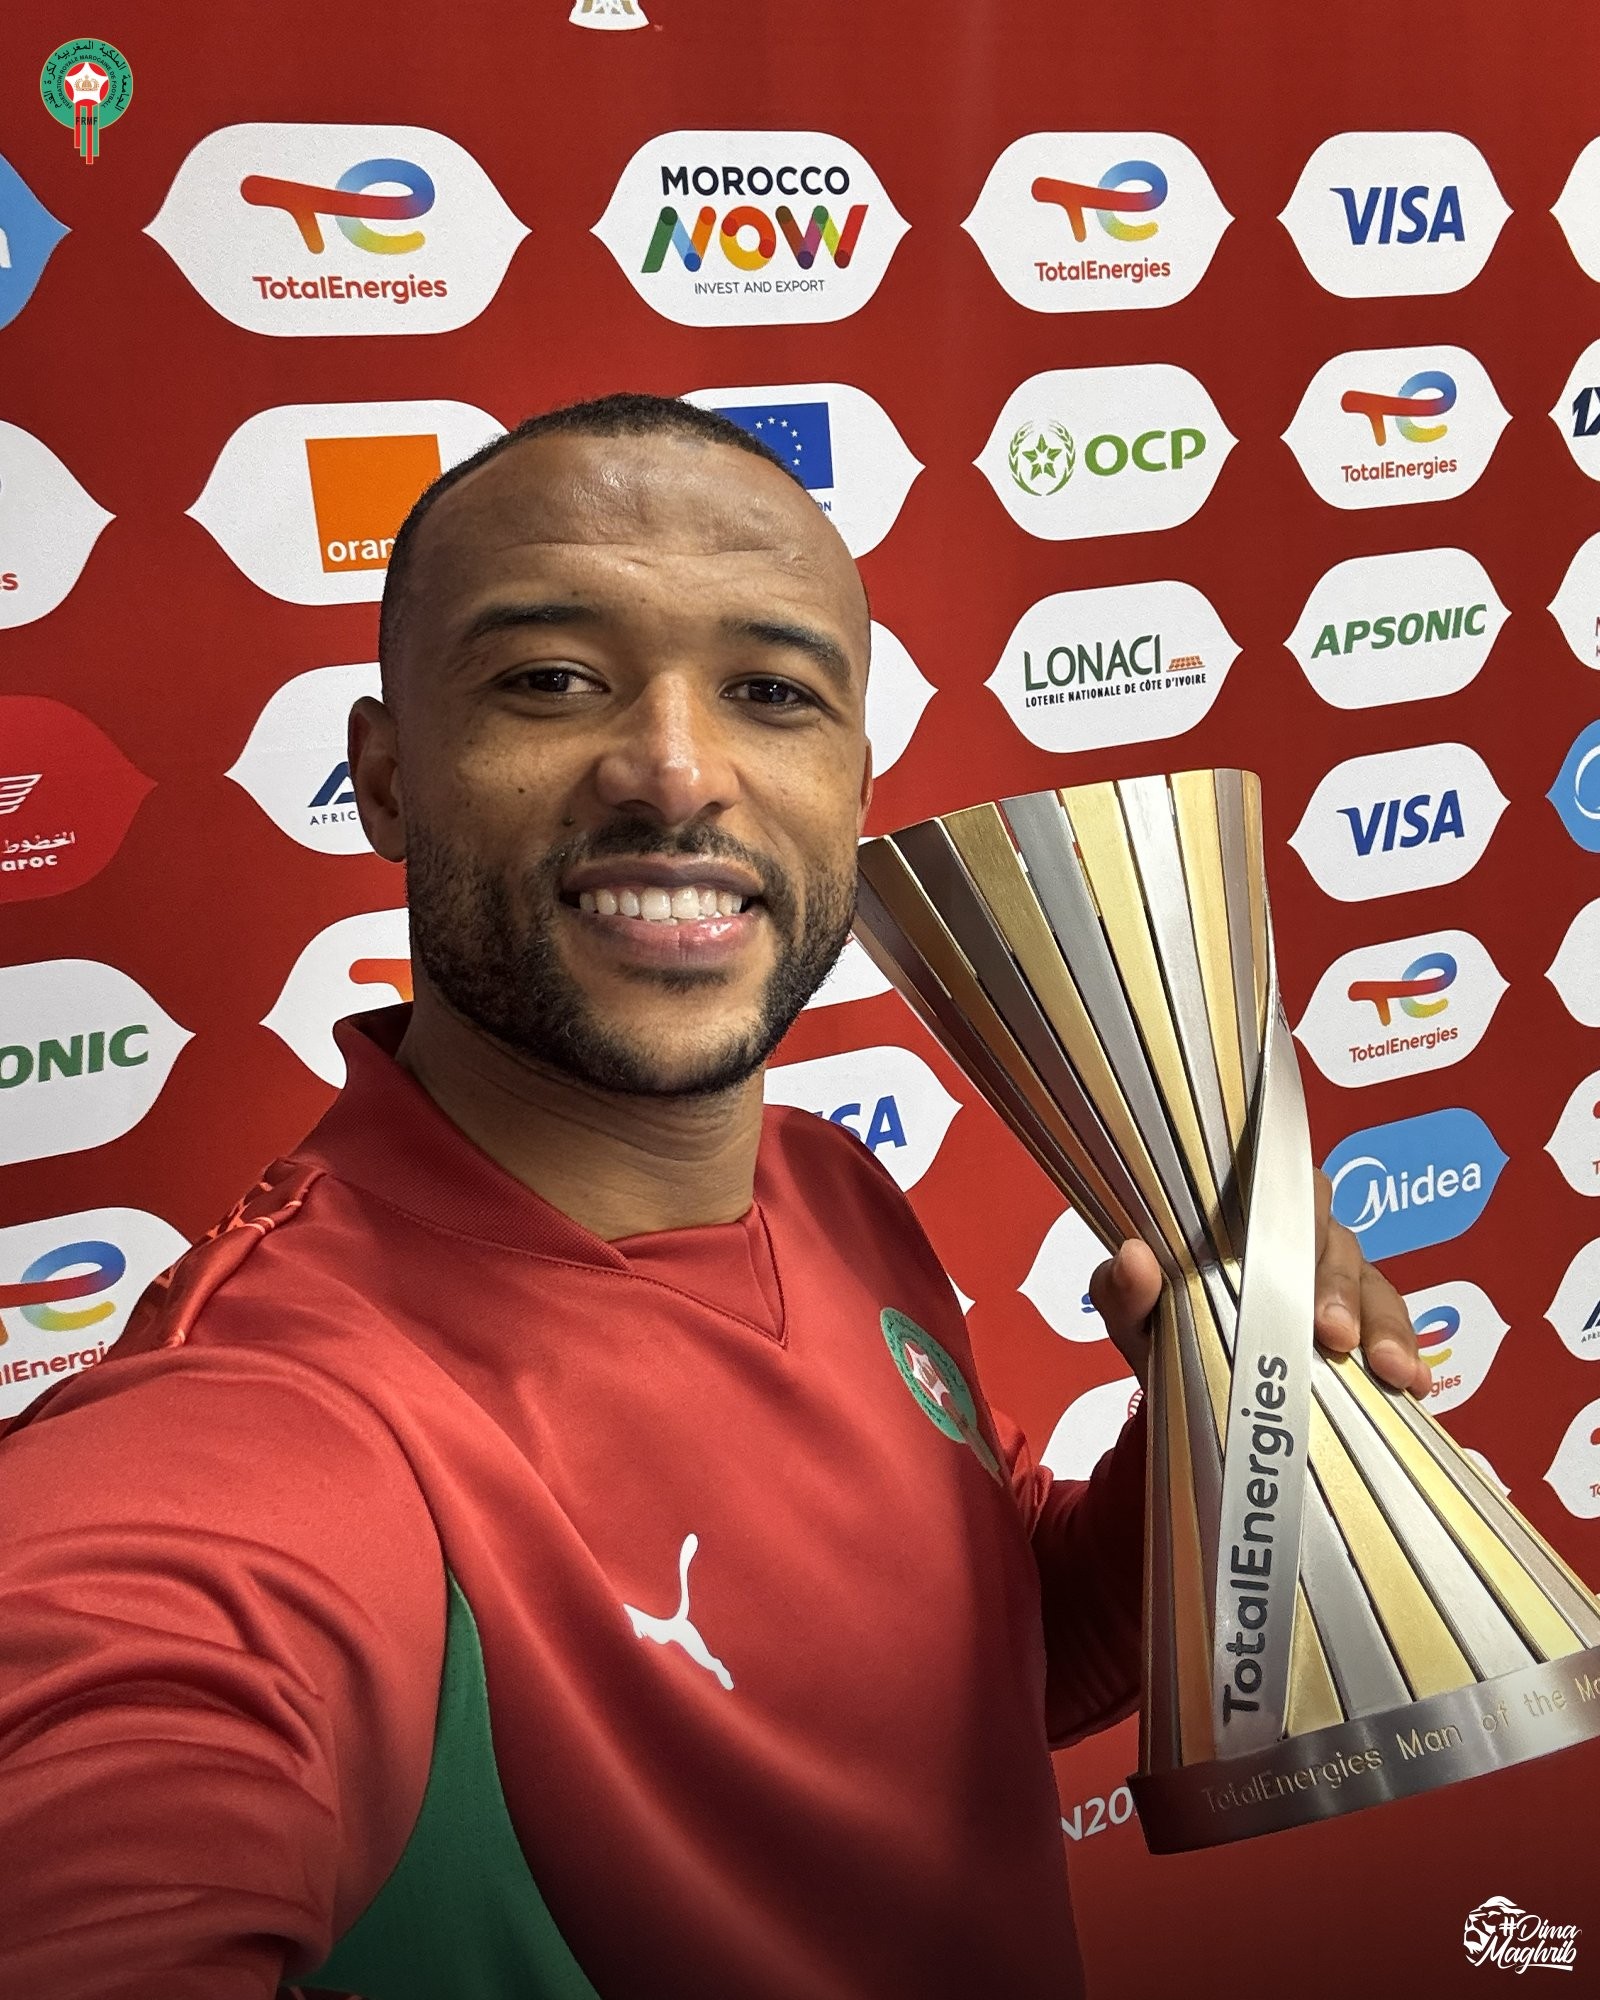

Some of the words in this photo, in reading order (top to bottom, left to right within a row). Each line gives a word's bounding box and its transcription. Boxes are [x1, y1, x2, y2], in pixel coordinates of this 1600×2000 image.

[661, 166, 850, 196] MOROCCO
[641, 204, 870, 273] NOW
[1330, 186, 1465, 245] VISA
[252, 273, 448, 304] TotalEnergies
[695, 282, 740, 295] INVEST
[743, 281, 772, 293] AND
[776, 279, 825, 292] EXPORT
[1034, 258, 1171, 283] TotalEnergies
[1085, 428, 1207, 476] OCP
[1341, 456, 1458, 483] TotalEnergies
[1311, 603, 1487, 659] APSONIC
[1024, 634, 1161, 691] LONACI
[1025, 693, 1065, 707] LOTERIE
[1068, 684, 1121, 701] NATIONALE
[1124, 683, 1137, 694] DE
[1139, 679, 1162, 692] CÔTE
[1165, 673, 1206, 689] D'IVOIRE
[1336, 789, 1465, 856] VISA
[1349, 1024, 1458, 1062] TotalEnergies
[1352, 1163, 1482, 1228] Midea
[1223, 1354, 1294, 1724] TotalEnergies
[1202, 1749, 1384, 1813] TotalEnergies
[1395, 1724, 1464, 1761] Man
[1482, 1705, 1511, 1734] of
[1523, 1689, 1567, 1718] the
